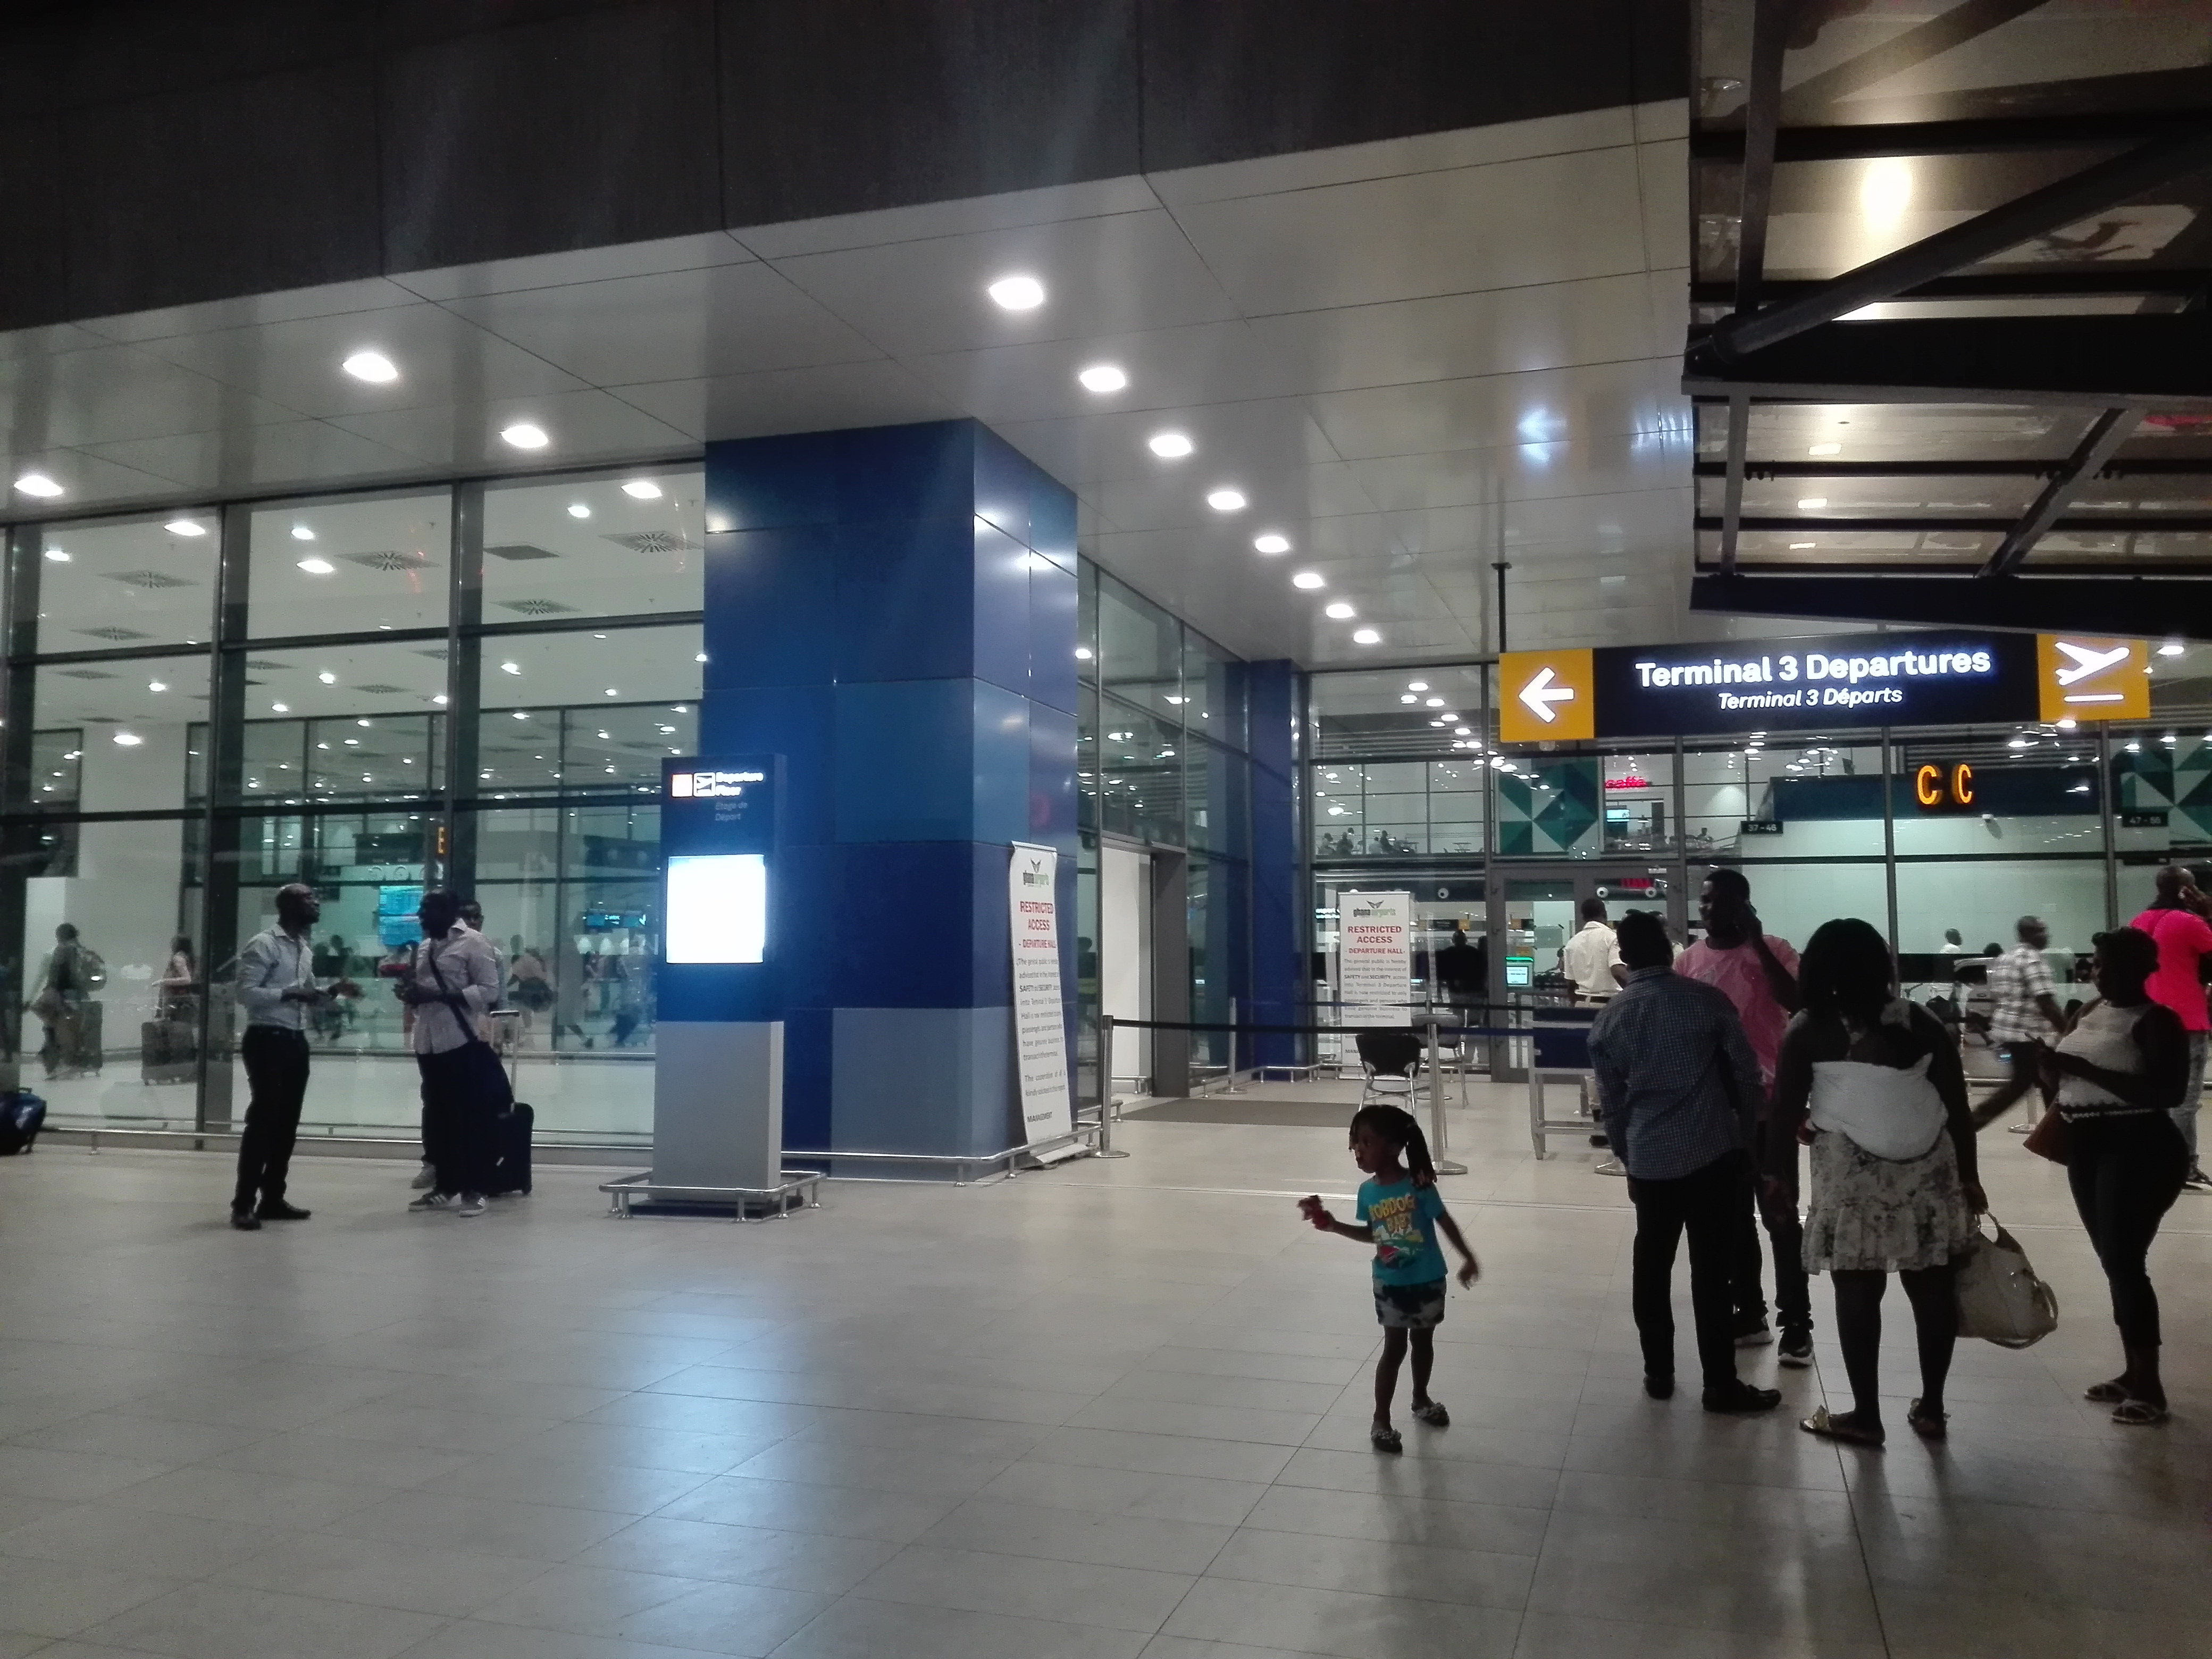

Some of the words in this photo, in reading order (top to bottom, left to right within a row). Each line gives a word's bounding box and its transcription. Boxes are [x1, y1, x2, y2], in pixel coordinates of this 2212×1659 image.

[1635, 656, 1773, 688] Terminal
[1779, 655, 1798, 681] 3
[1806, 650, 1991, 684] Departures
[1718, 689, 1802, 710] Terminal
[1806, 689, 1819, 706] 3
[1823, 687, 1903, 708] Départs
[1917, 765, 1942, 805] C
[1957, 764, 1972, 803] C
[1020, 901, 1054, 914] RESTRICTED
[1028, 918, 1050, 931] ACCESS
